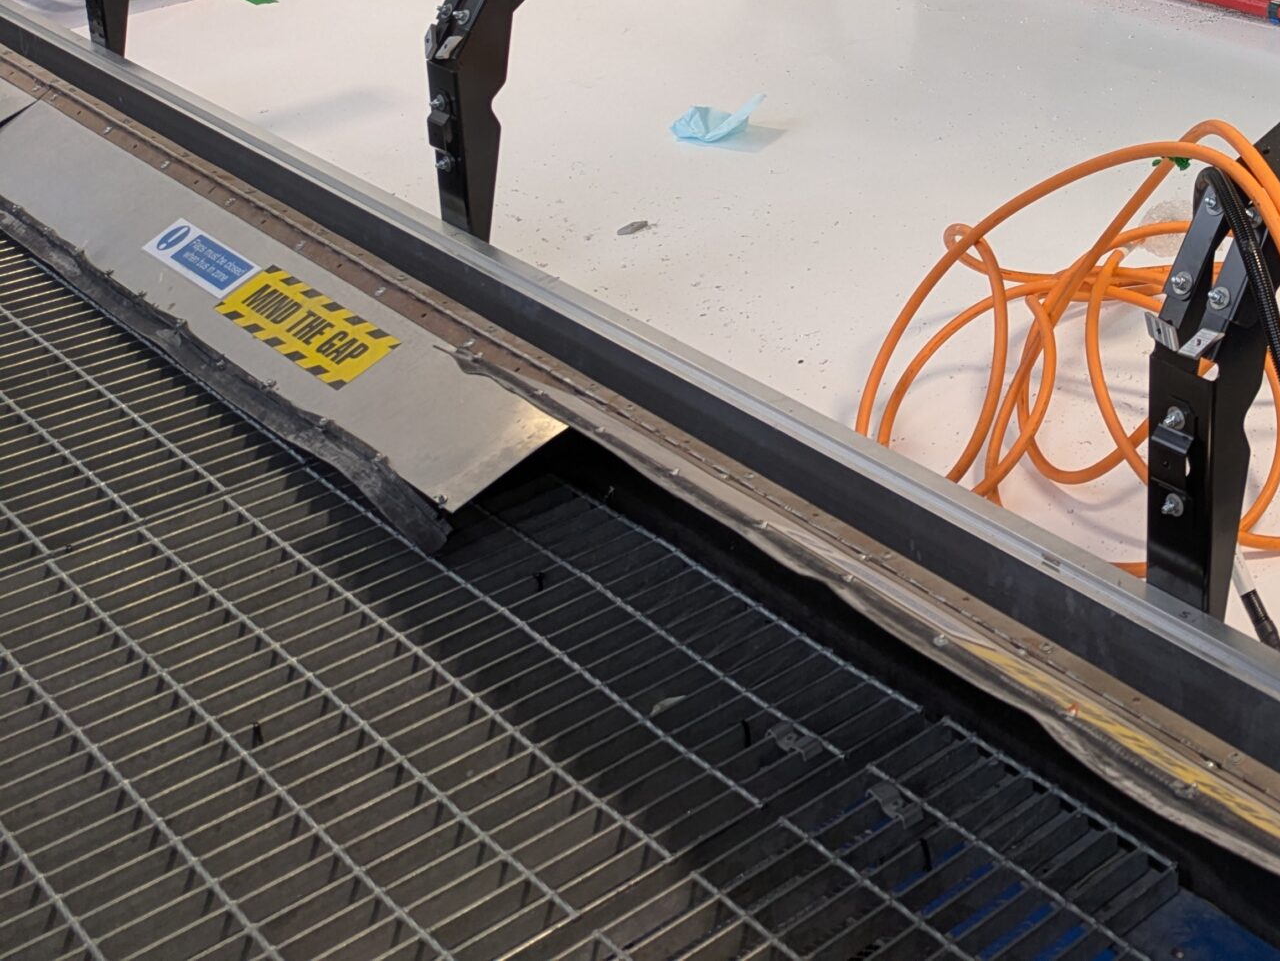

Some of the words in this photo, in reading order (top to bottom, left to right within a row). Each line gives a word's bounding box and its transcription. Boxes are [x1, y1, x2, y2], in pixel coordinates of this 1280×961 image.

[183, 250, 200, 264] when
[196, 258, 210, 270] bus
[207, 264, 216, 273] in
[212, 270, 229, 282] zone
[191, 239, 207, 253] Flaps
[204, 246, 221, 261] must
[216, 253, 228, 266] be
[224, 261, 248, 277] closed
[242, 283, 302, 325] MIND
[286, 309, 336, 345] THE
[315, 330, 369, 365] GAP
